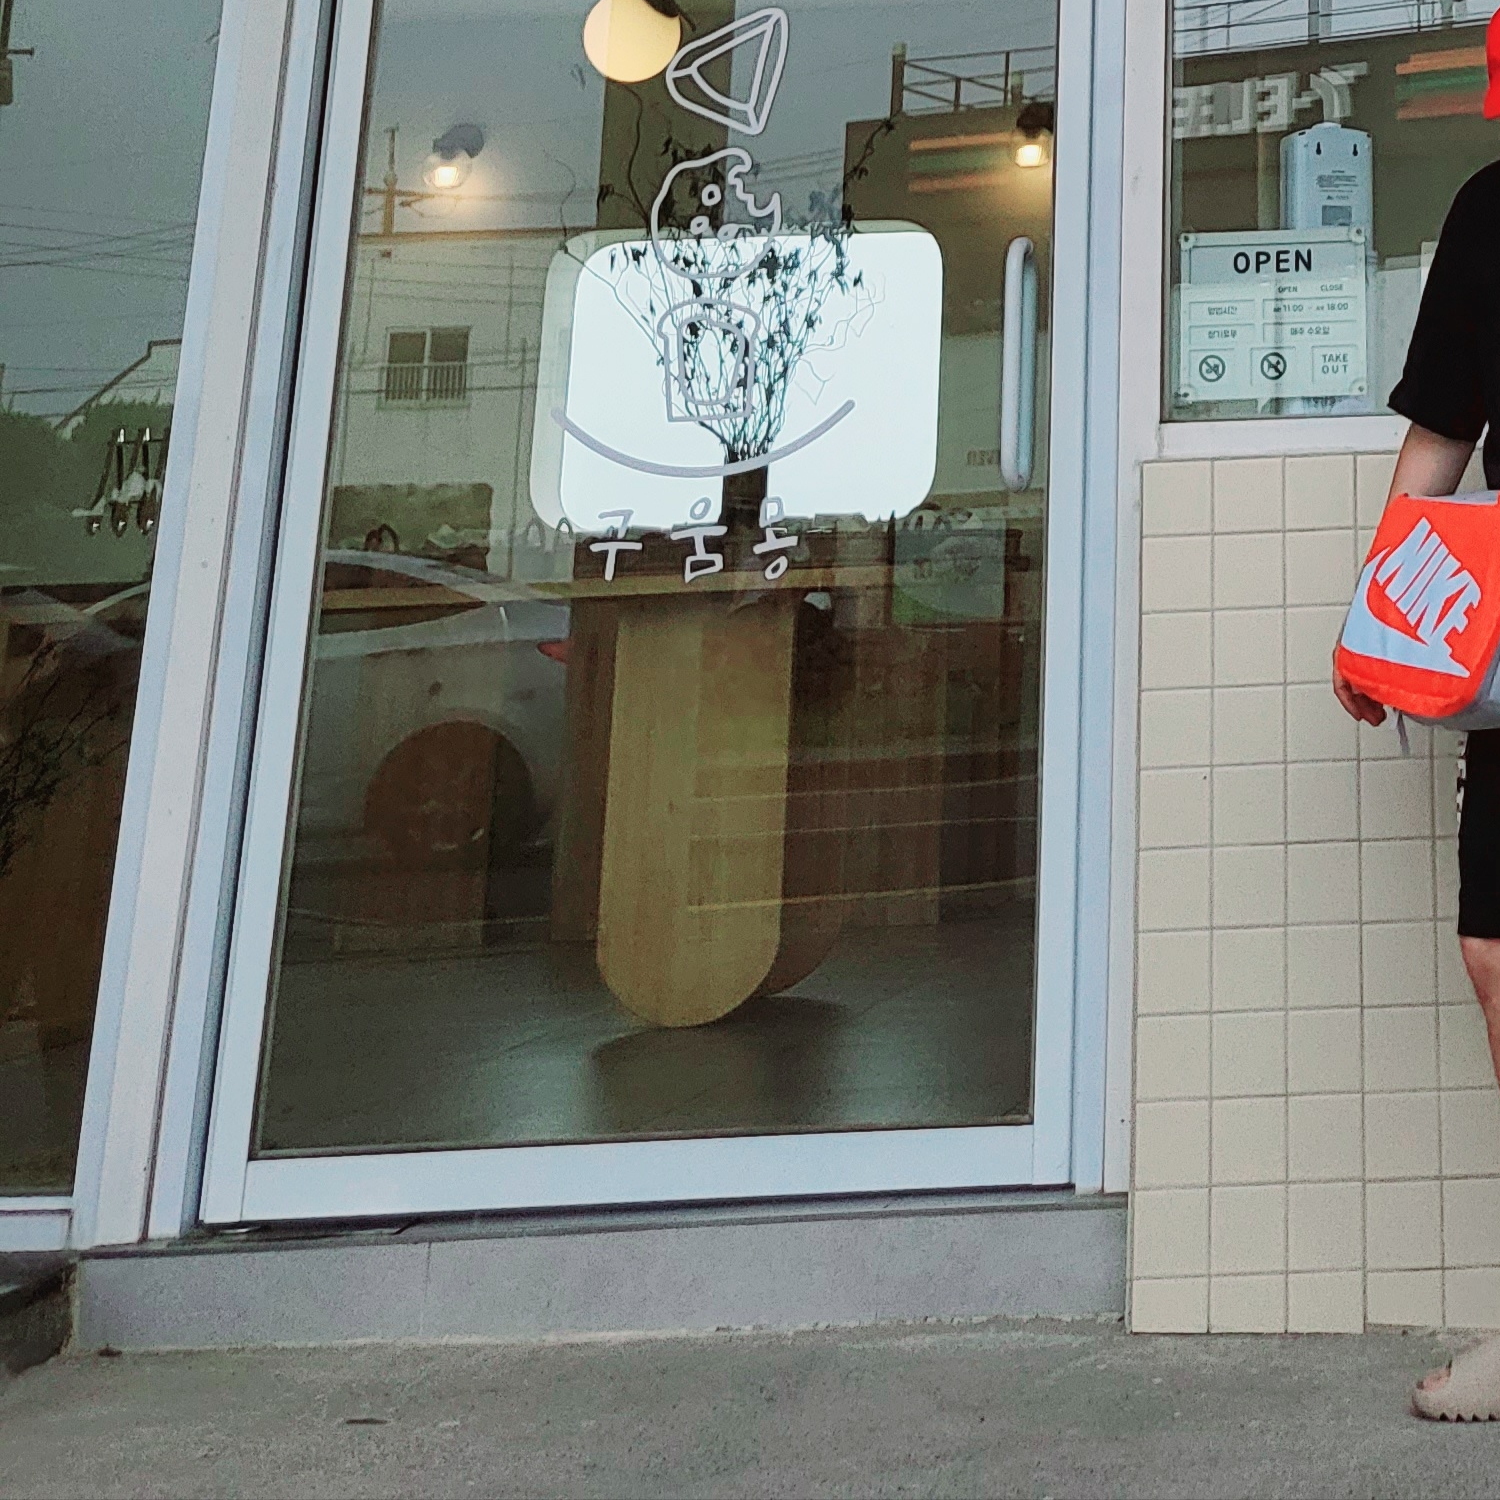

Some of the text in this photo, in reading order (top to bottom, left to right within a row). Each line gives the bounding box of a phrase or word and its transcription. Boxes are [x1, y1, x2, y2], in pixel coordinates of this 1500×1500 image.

[1233, 248, 1313, 274] OPEN
[1277, 283, 1344, 294] OPEN CLOSE
[1322, 353, 1349, 363] TAKE
[1321, 364, 1349, 375] OUT
[1375, 516, 1482, 648] NIKE
